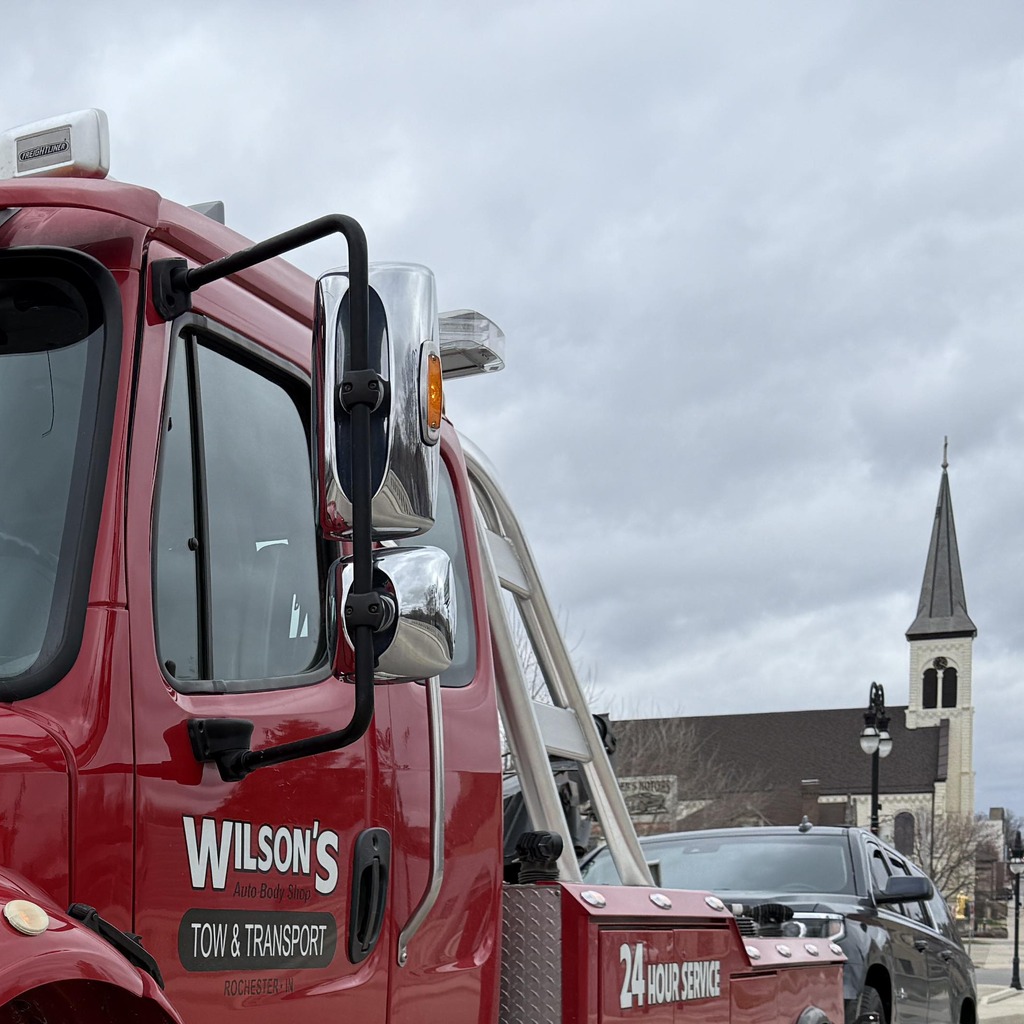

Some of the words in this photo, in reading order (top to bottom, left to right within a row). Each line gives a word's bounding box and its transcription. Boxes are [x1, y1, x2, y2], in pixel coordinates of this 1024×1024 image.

[182, 815, 340, 896] WILSON'S
[233, 881, 257, 898] Auto
[259, 883, 285, 903] Body
[287, 884, 312, 903] Shop
[191, 923, 227, 958] TOW
[231, 923, 241, 957] &
[245, 924, 327, 957] TRANSPORT
[224, 978, 278, 996] ROCHESTER
[285, 977, 295, 993] IN
[619, 942, 645, 1009] 24
[647, 963, 679, 1005] HOUR
[681, 960, 720, 1000] SERVICE
